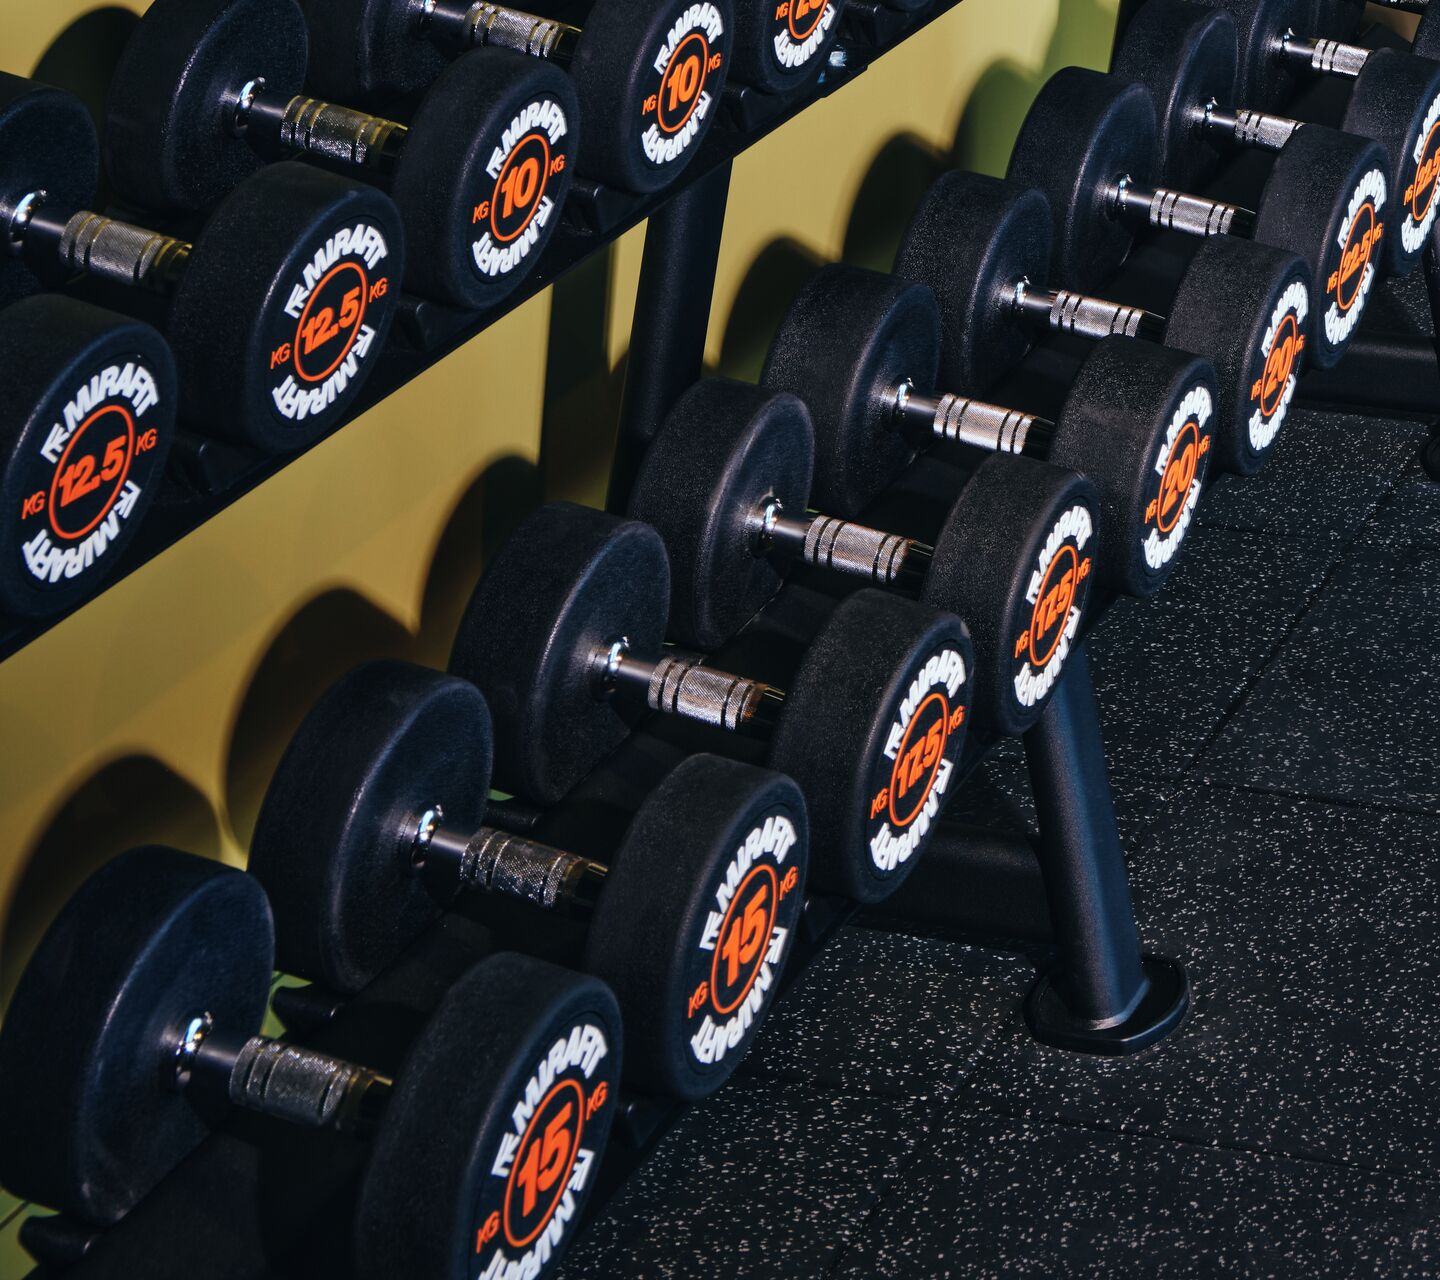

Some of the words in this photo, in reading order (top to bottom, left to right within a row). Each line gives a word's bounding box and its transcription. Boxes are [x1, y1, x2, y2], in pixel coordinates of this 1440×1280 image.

[667, 2, 724, 53] MIRAFIT
[642, 94, 657, 115] KG
[667, 54, 700, 111] 10
[707, 52, 721, 73] KG
[501, 100, 568, 154] MIRAFIT
[472, 200, 490, 224] KG
[501, 157, 539, 219] 10
[549, 154, 566, 177] KG
[302, 223, 388, 290] MIRAFIT
[472, 219, 539, 276] MIRAFIT
[270, 343, 291, 370] KG
[301, 286, 360, 355] 12.5
[368, 277, 388, 303] KG
[62, 362, 159, 432] MIRAFIT
[272, 352, 359, 420] MIRAFIT
[1263, 336, 1292, 400] 20
[21, 491, 46, 520] KG
[59, 435, 126, 508] 12.5
[135, 428, 158, 456] KG
[1161, 443, 1194, 516] 20
[22, 510, 120, 583] MIRAFIT
[900, 649, 966, 728] MIRAFIT
[870, 788, 889, 820] KG
[947, 705, 966, 735] KG
[716, 815, 797, 913] MIRAFIT
[688, 981, 708, 1019] KG
[722, 884, 767, 987] 15
[779, 866, 798, 901] KG
[690, 962, 773, 1064] MIRAFIT
[512, 1024, 608, 1136] MIRAFIT
[476, 1210, 500, 1254] KG
[517, 1101, 572, 1217] 15
[586, 1081, 609, 1120] KG
